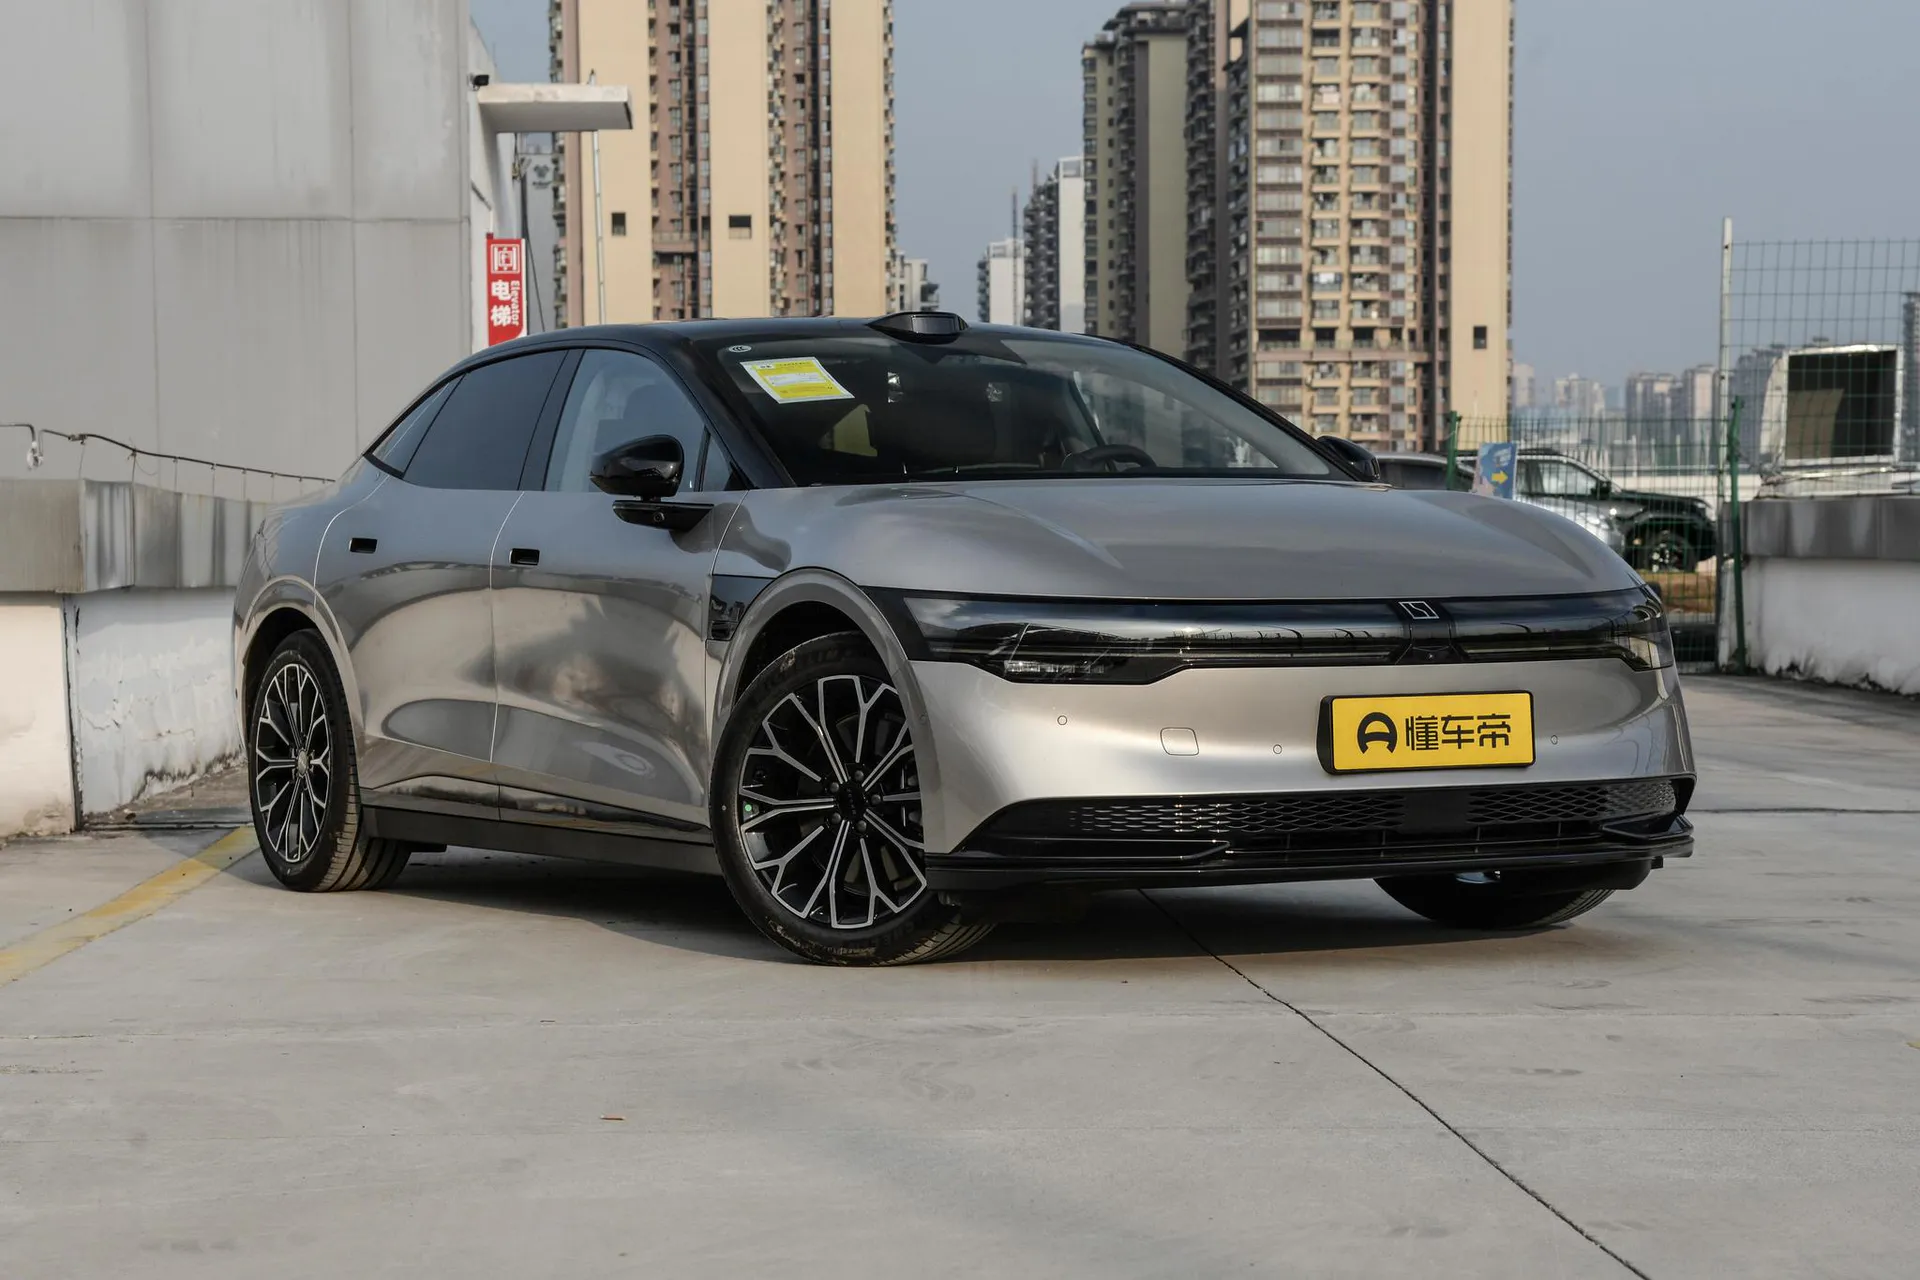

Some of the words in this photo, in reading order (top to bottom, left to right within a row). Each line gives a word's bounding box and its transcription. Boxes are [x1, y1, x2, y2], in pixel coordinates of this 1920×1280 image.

[491, 280, 511, 327] 电梯
[1405, 713, 1511, 751] 懂车帝
